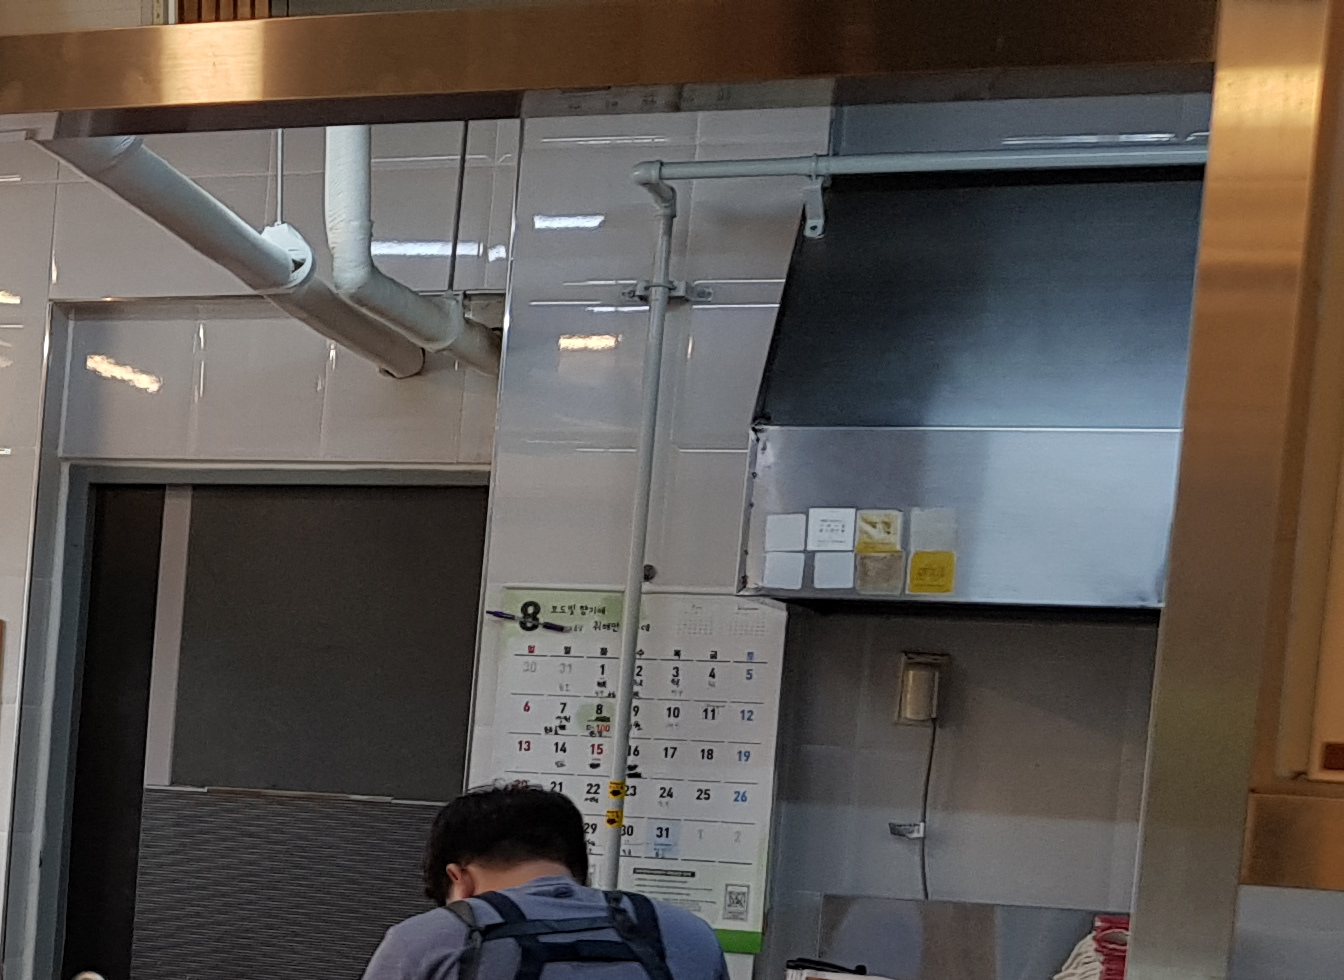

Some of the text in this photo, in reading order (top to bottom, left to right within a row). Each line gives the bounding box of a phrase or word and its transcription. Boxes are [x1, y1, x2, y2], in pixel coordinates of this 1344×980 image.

[519, 601, 541, 631] 8
[599, 664, 605, 675] 1
[636, 665, 643, 677] 2
[672, 666, 679, 678] 3
[708, 667, 716, 679] 4
[745, 669, 753, 680] 5
[523, 701, 754, 721] 6 7 8 9 10 11 12
[518, 740, 751, 762] 13 14 15 16 17 18 19
[550, 781, 563, 793] 21
[586, 783, 600, 795] 22
[624, 785, 637, 797] 23
[659, 786, 673, 799] 24
[696, 788, 711, 800] 25
[733, 790, 747, 802] 26
[584, 822, 597, 834] 29
[620, 825, 633, 837] 30
[656, 827, 670, 839] 31
